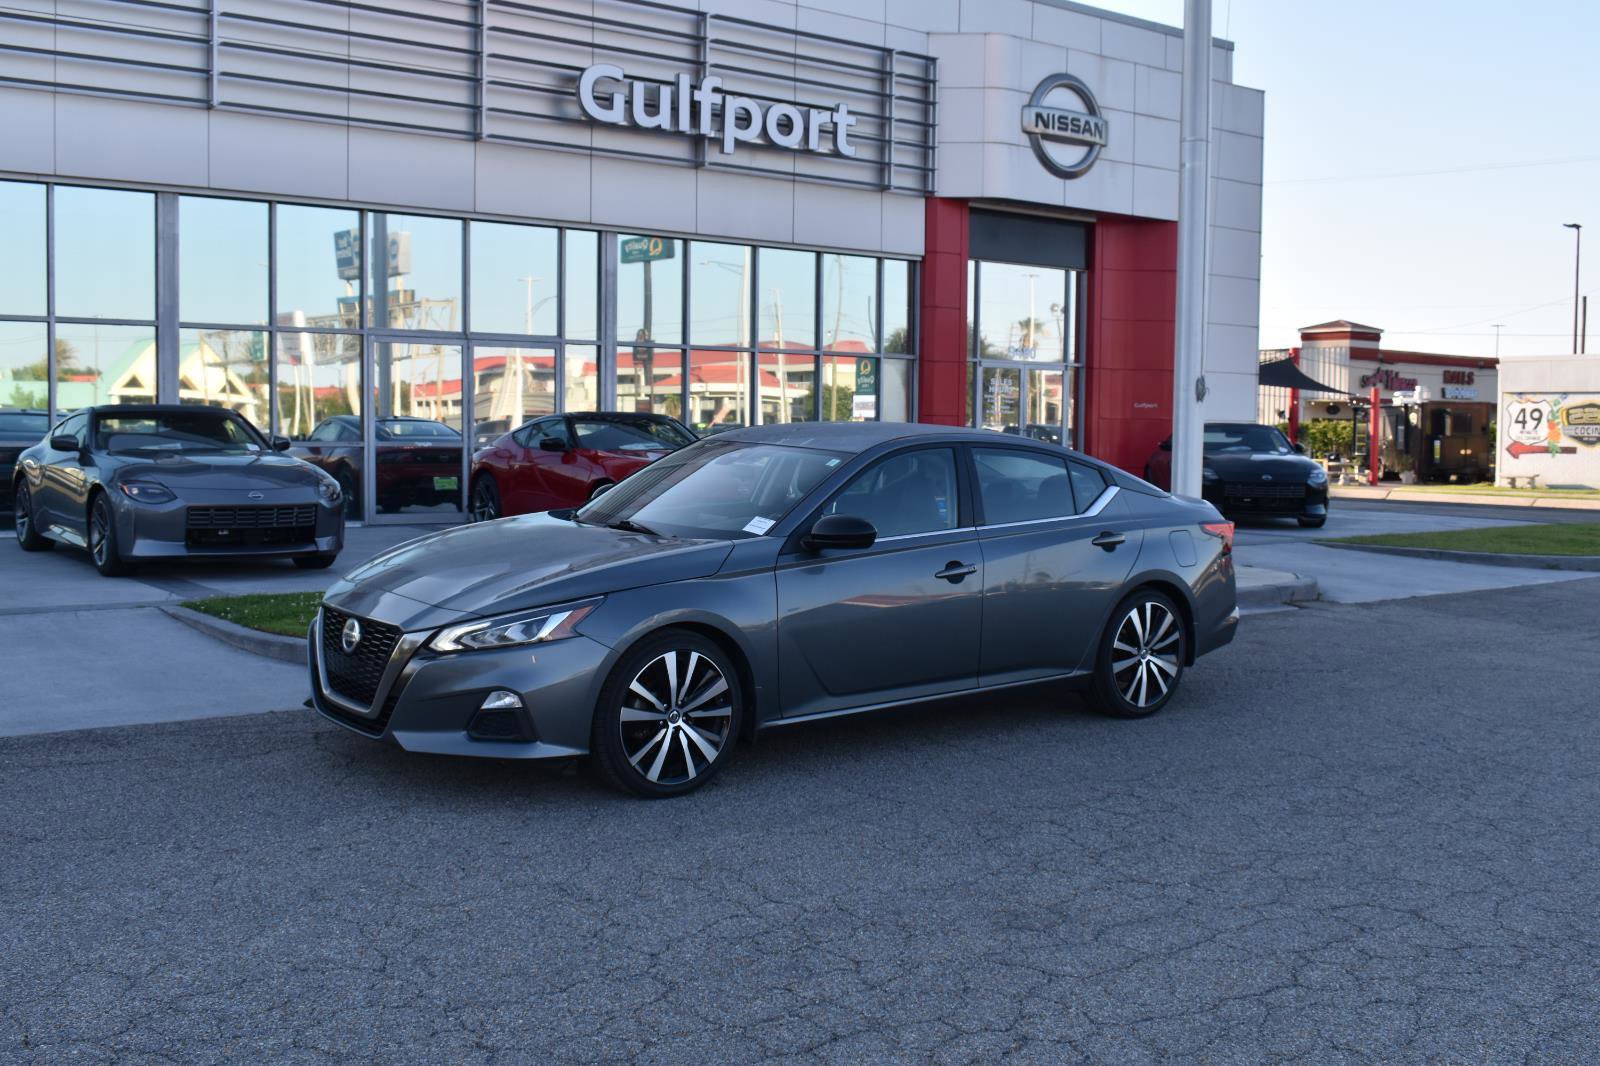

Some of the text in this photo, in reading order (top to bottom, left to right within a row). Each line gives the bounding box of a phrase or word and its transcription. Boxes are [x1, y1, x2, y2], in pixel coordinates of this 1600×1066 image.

[577, 63, 857, 156] Gulfport
[1034, 111, 1104, 139] NISSAN
[1514, 408, 1544, 430] 49
